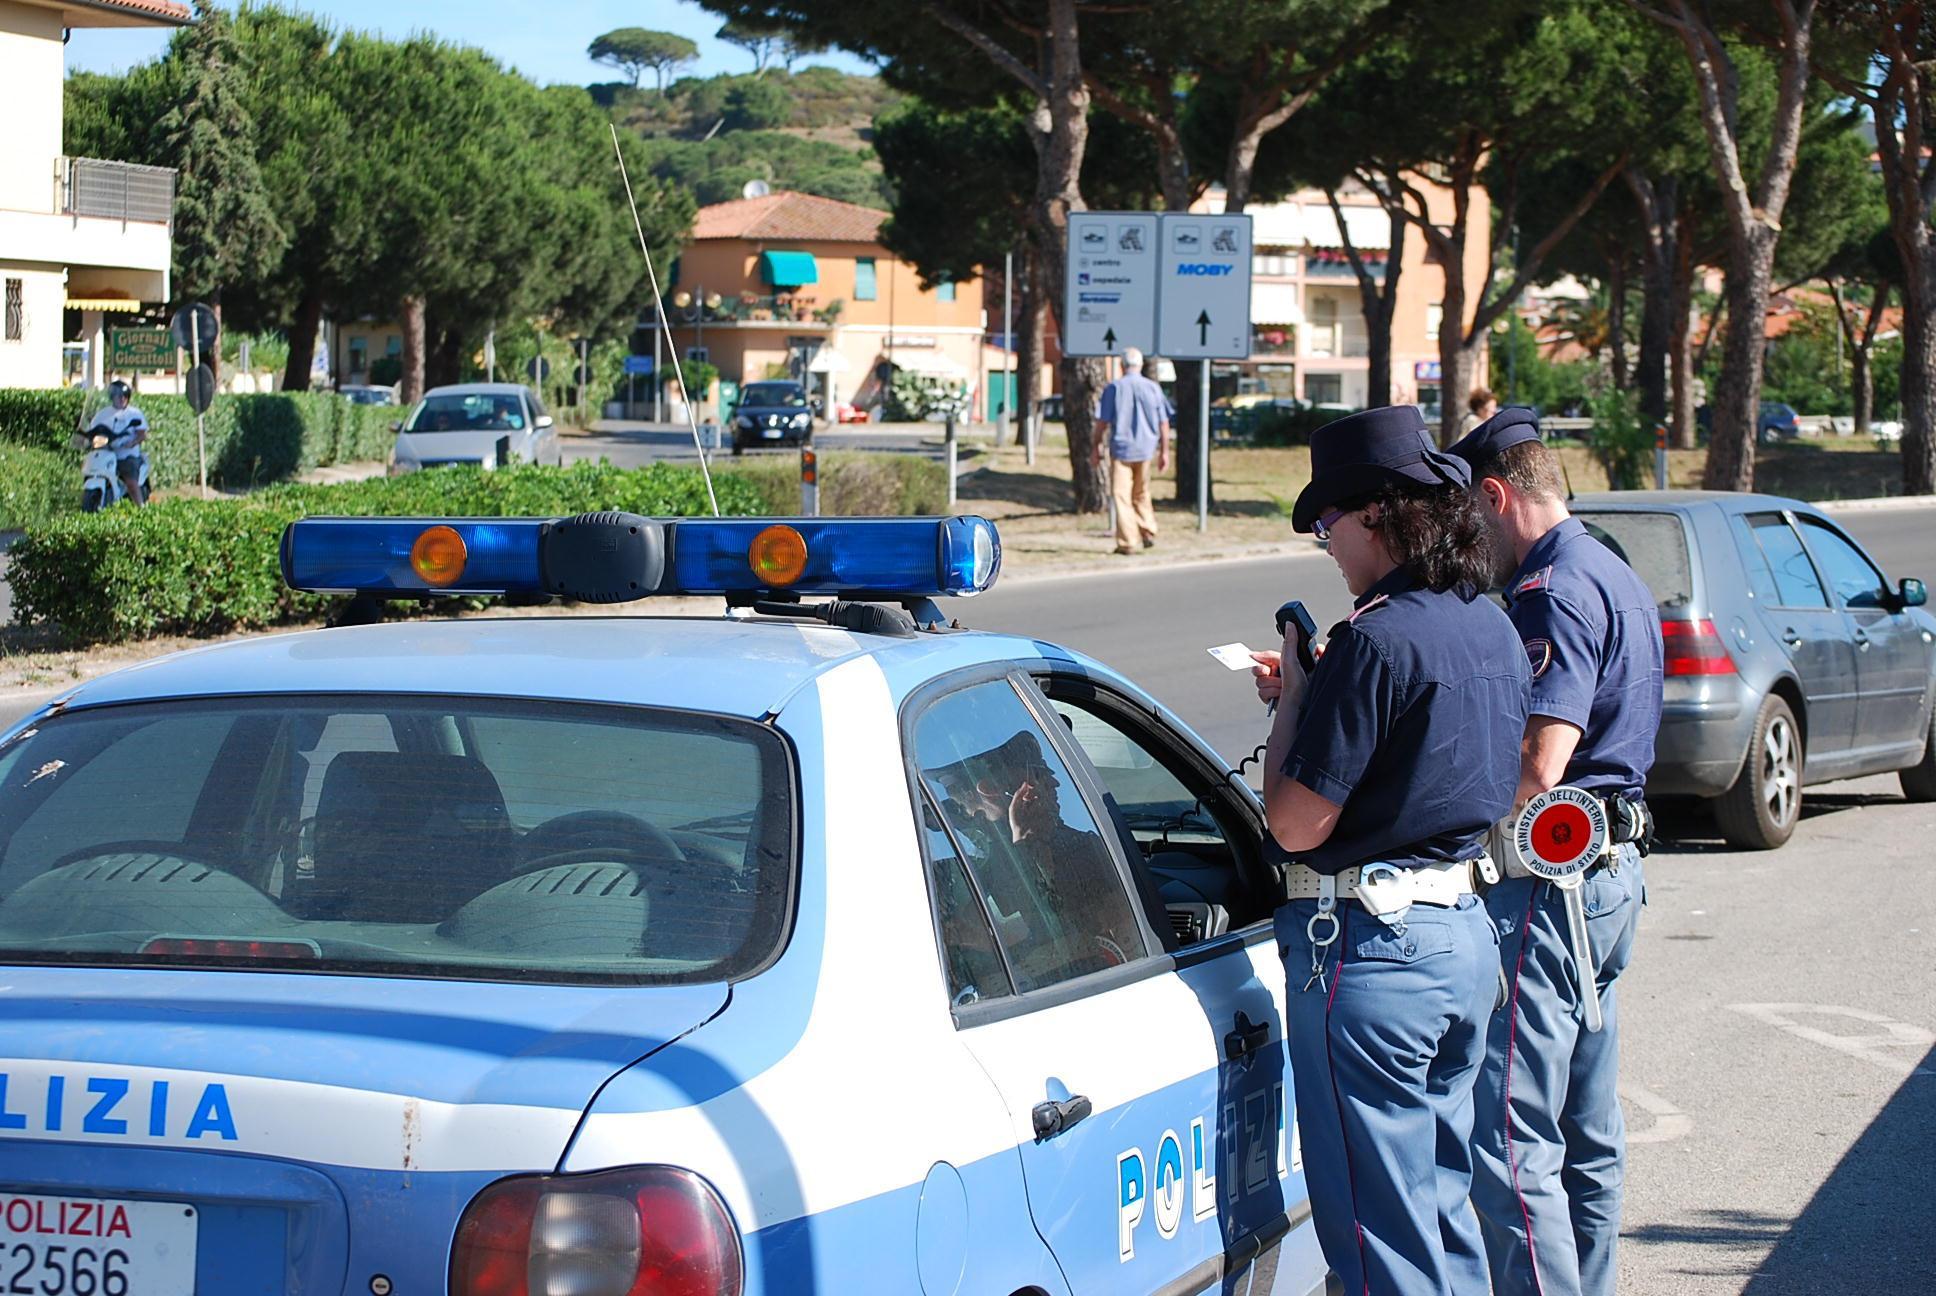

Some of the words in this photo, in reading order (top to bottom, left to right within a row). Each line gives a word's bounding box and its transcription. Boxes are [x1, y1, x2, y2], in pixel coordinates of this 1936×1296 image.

[1177, 264, 1233, 276] MOBY
[118, 331, 170, 348] Giornali
[115, 350, 174, 366] Giocattoli
[1518, 798, 1546, 852] MINISTERO
[1549, 790, 1604, 832] DELL'INTERNO
[1530, 859, 1562, 876] POLIZIA
[1577, 843, 1600, 868] STATO
[0, 1198, 131, 1238] OLIZIA
[0, 1243, 129, 1296] 2566
